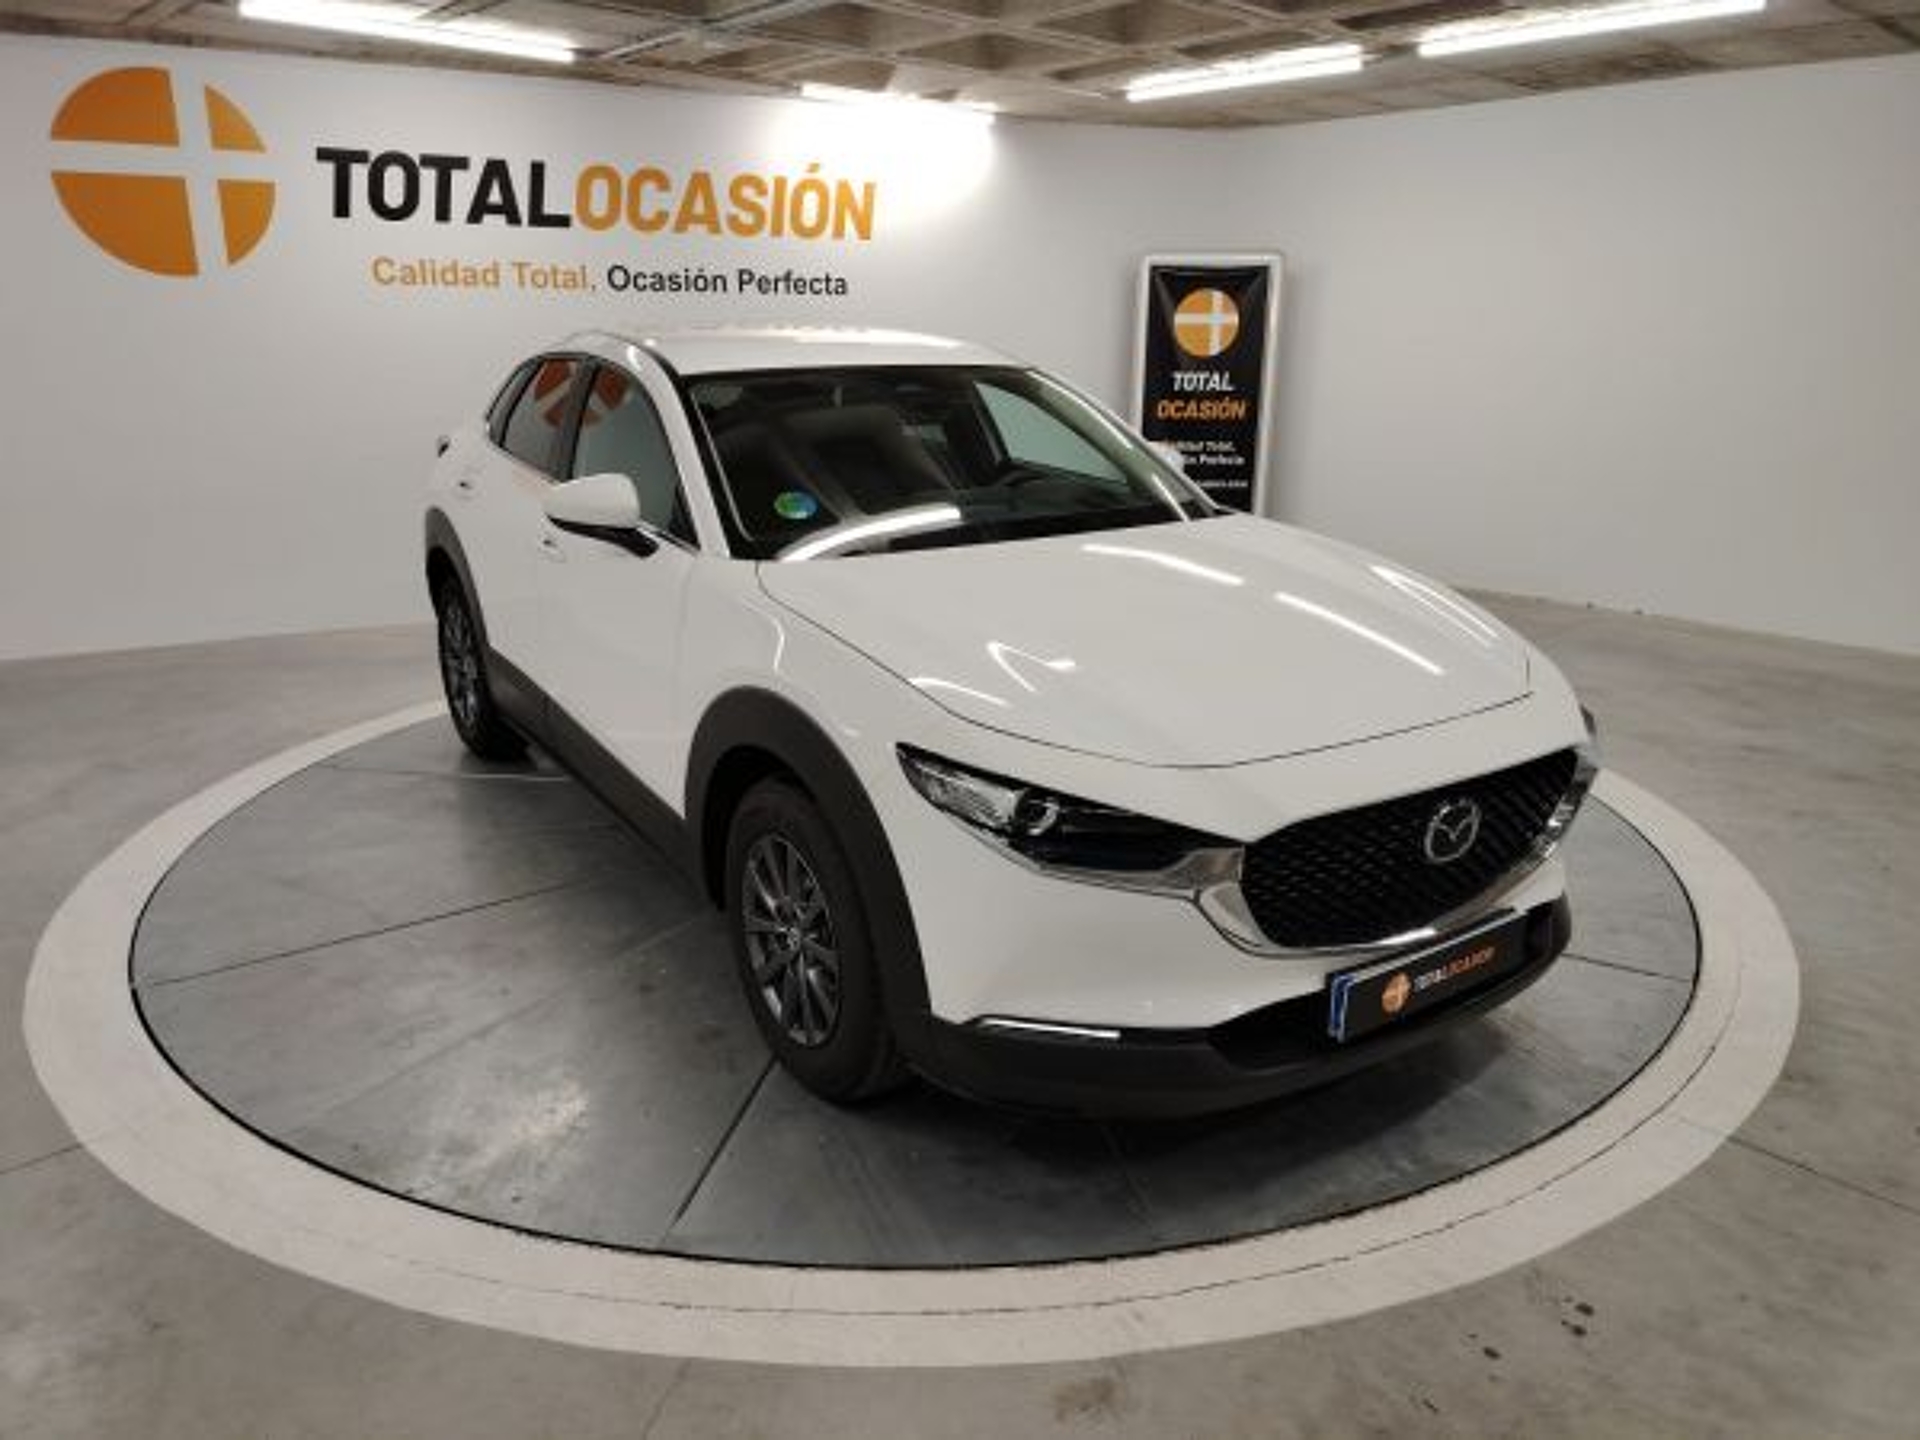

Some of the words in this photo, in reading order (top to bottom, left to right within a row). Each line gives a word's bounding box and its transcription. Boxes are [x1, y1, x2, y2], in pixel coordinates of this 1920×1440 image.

[371, 256, 500, 288] Calidad
[606, 263, 728, 293] Ocasión
[737, 269, 849, 296] Perfecta
[1172, 371, 1235, 392] TOTAL
[1157, 397, 1246, 419] OCASIÓN
